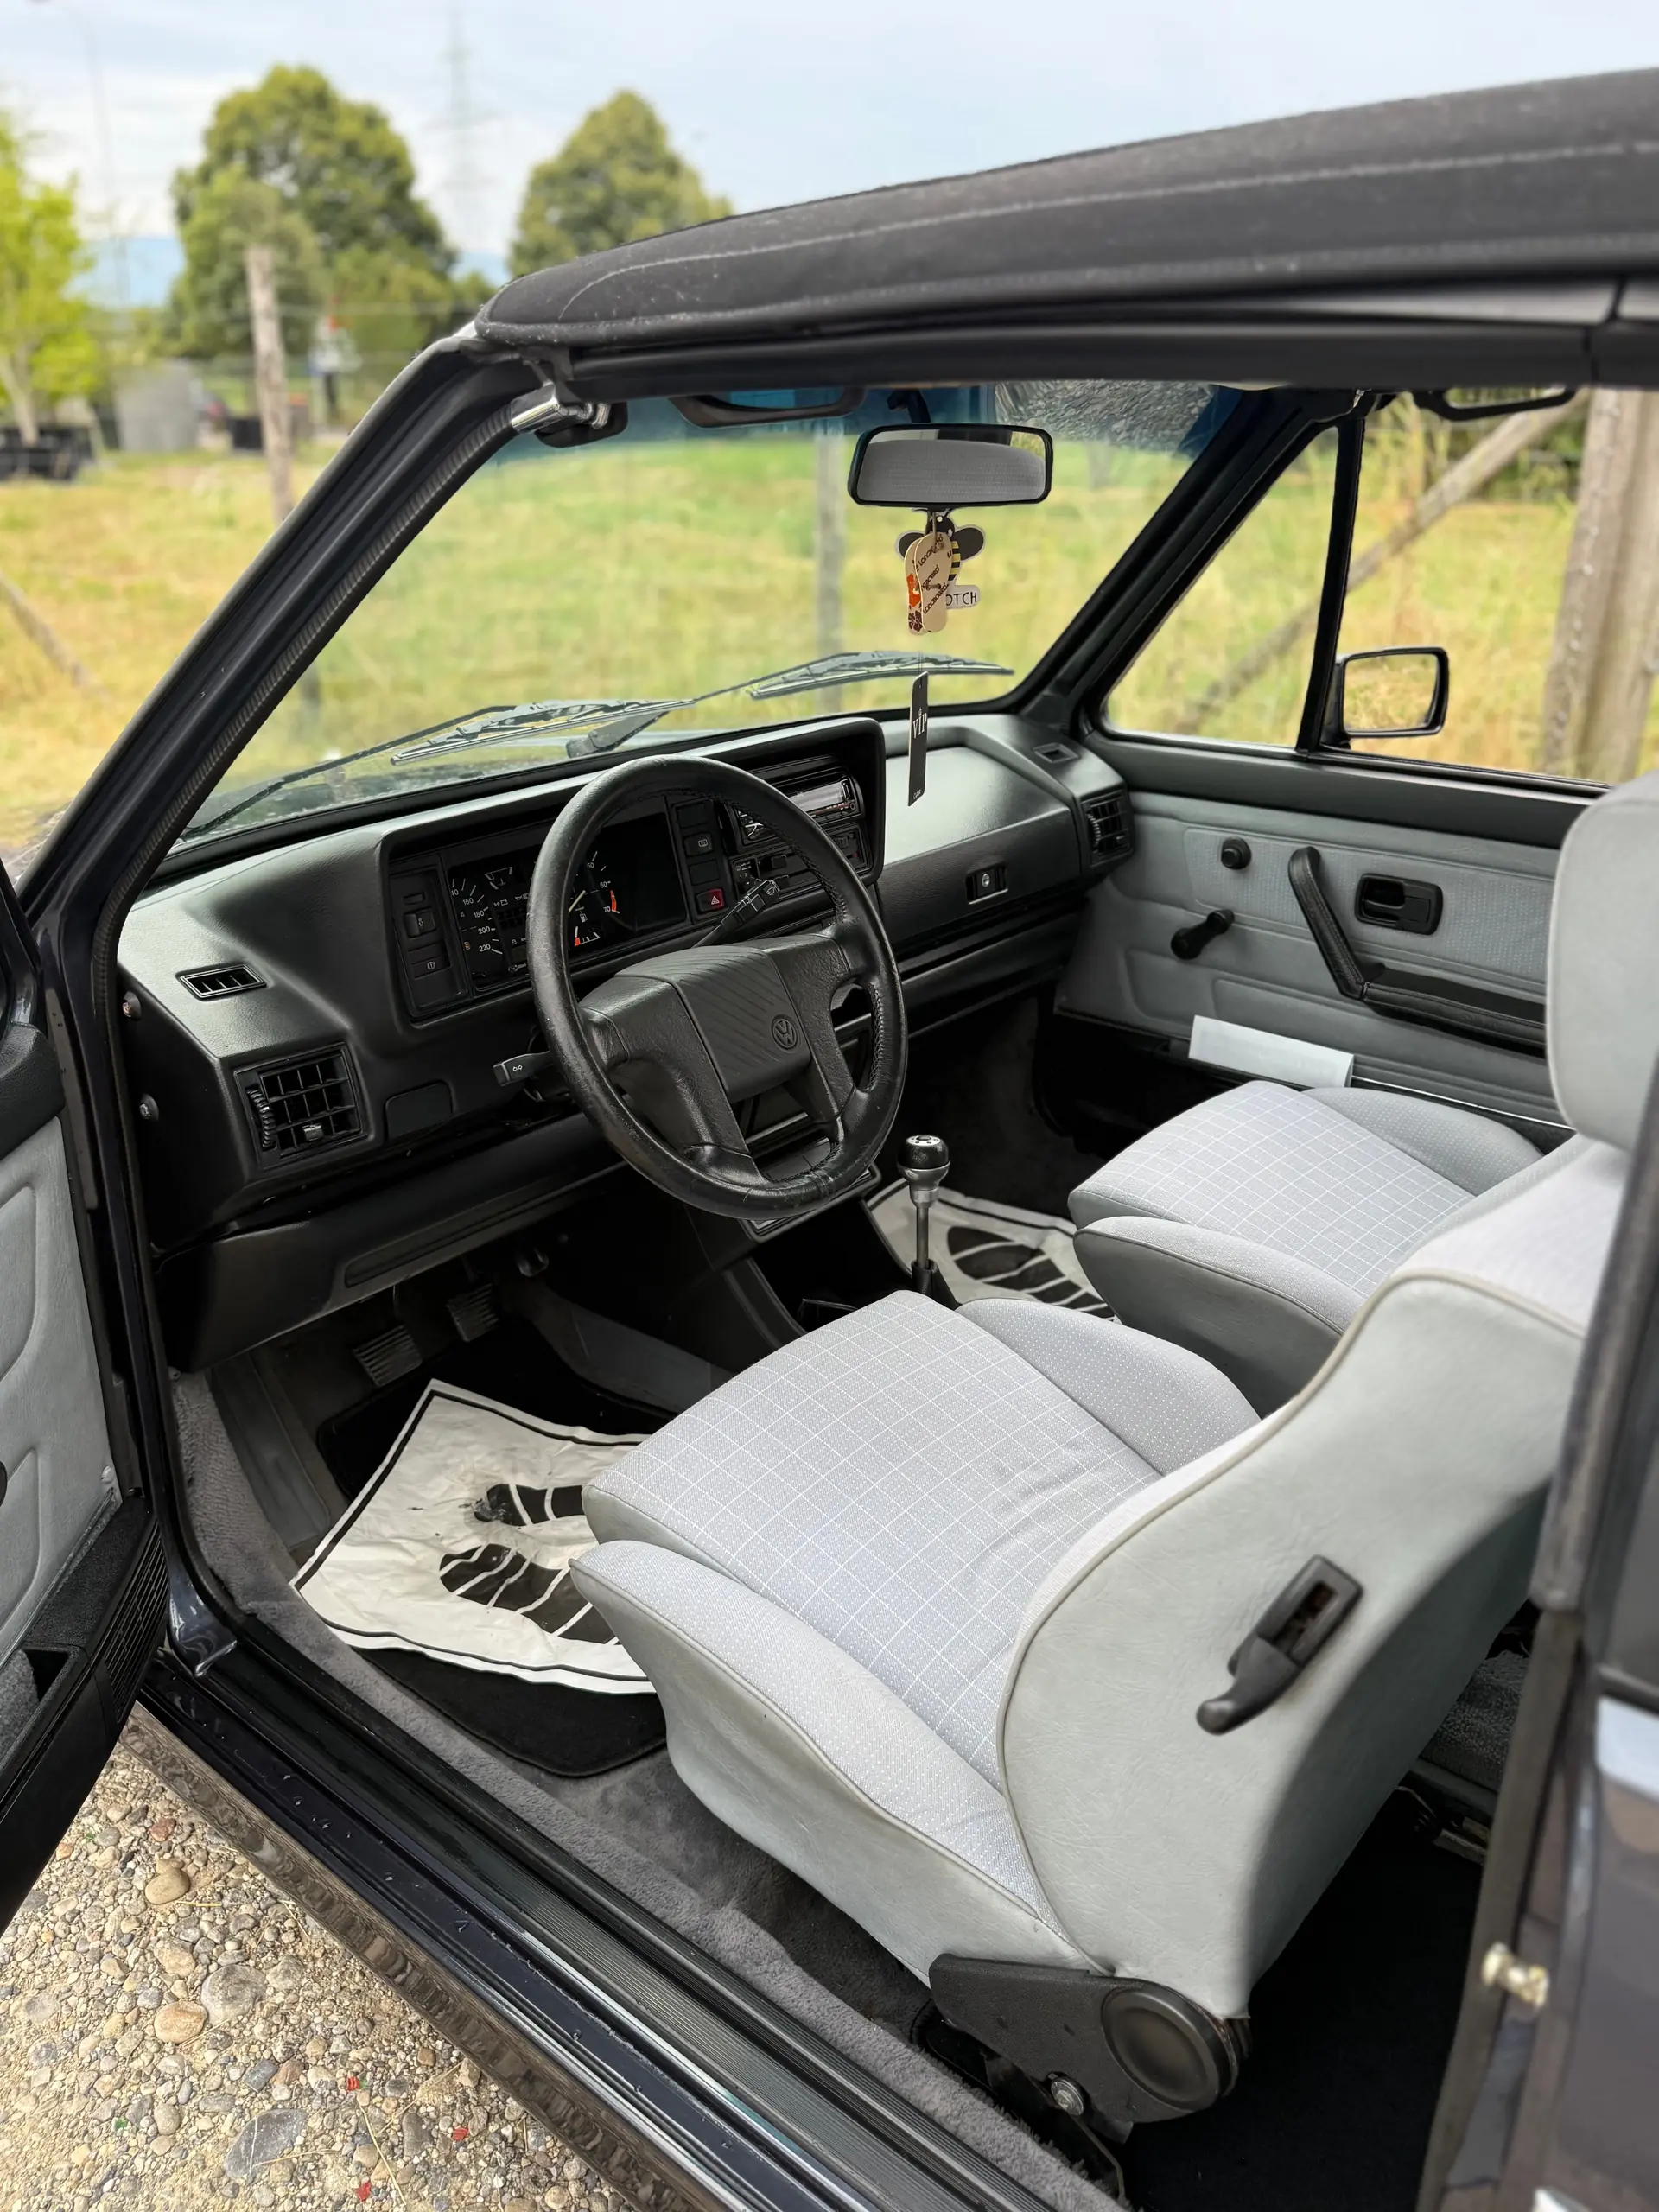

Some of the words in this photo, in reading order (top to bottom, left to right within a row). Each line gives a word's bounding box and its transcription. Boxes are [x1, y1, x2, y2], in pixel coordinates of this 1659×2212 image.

[912, 713, 928, 739] VIP
[600, 880, 608, 889] 60
[462, 897, 474, 906] 160
[473, 910, 485, 918] 180
[478, 925, 491, 935] 200
[479, 943, 492, 952] 220
